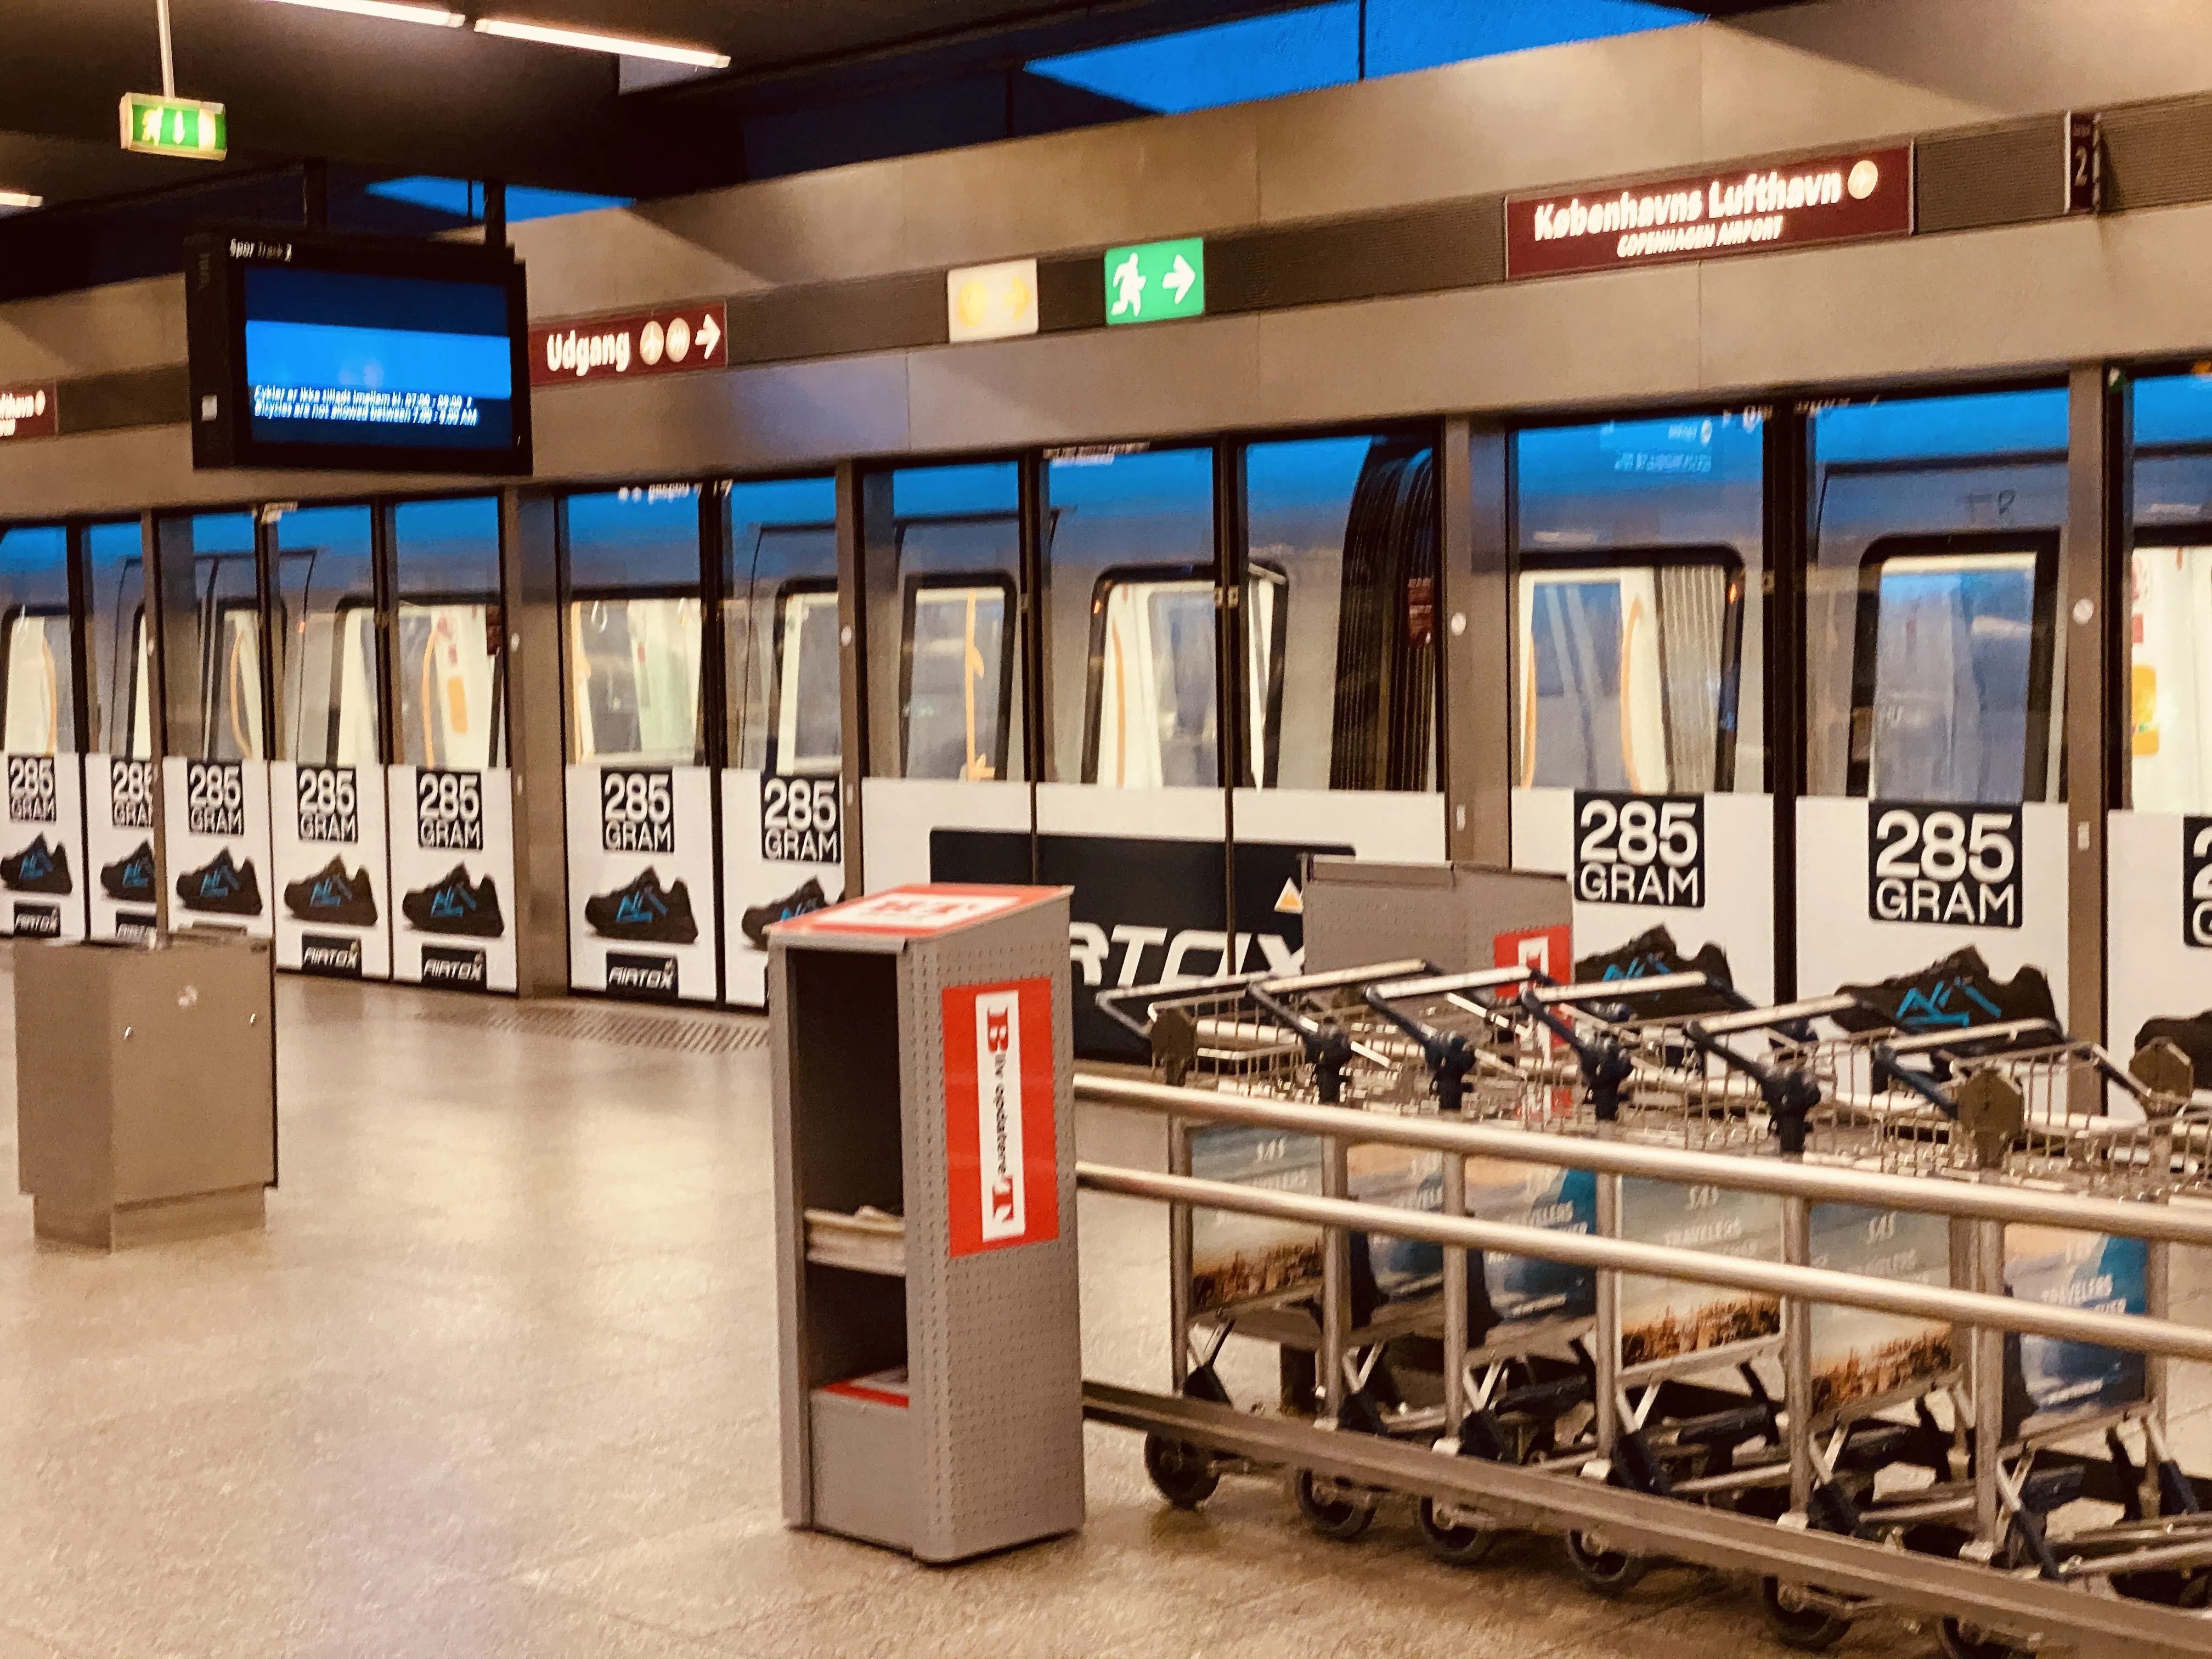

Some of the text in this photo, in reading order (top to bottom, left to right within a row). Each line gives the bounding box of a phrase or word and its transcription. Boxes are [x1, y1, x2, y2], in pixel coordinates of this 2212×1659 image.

[2074, 146, 2087, 187] 2
[1534, 171, 1842, 241] Københavns Lufthavn
[1617, 216, 1784, 258] COPENHAGEN AIRPORT
[547, 330, 630, 376] Udgang
[10, 758, 53, 798] 285
[190, 765, 240, 808] 285
[300, 769, 354, 815] 285
[420, 773, 479, 821] 285
[604, 773, 670, 823] 285
[191, 806, 242, 834] GRAM
[764, 778, 836, 831] 285
[300, 812, 356, 842] GRAM
[421, 820, 480, 849] GRAM
[605, 821, 671, 851] GRAM
[765, 829, 837, 862] GRAM
[1581, 799, 1697, 867] 285
[1876, 809, 2015, 883] 285
[1581, 862, 1698, 906] GRAM
[1876, 879, 2015, 926] GRAM
